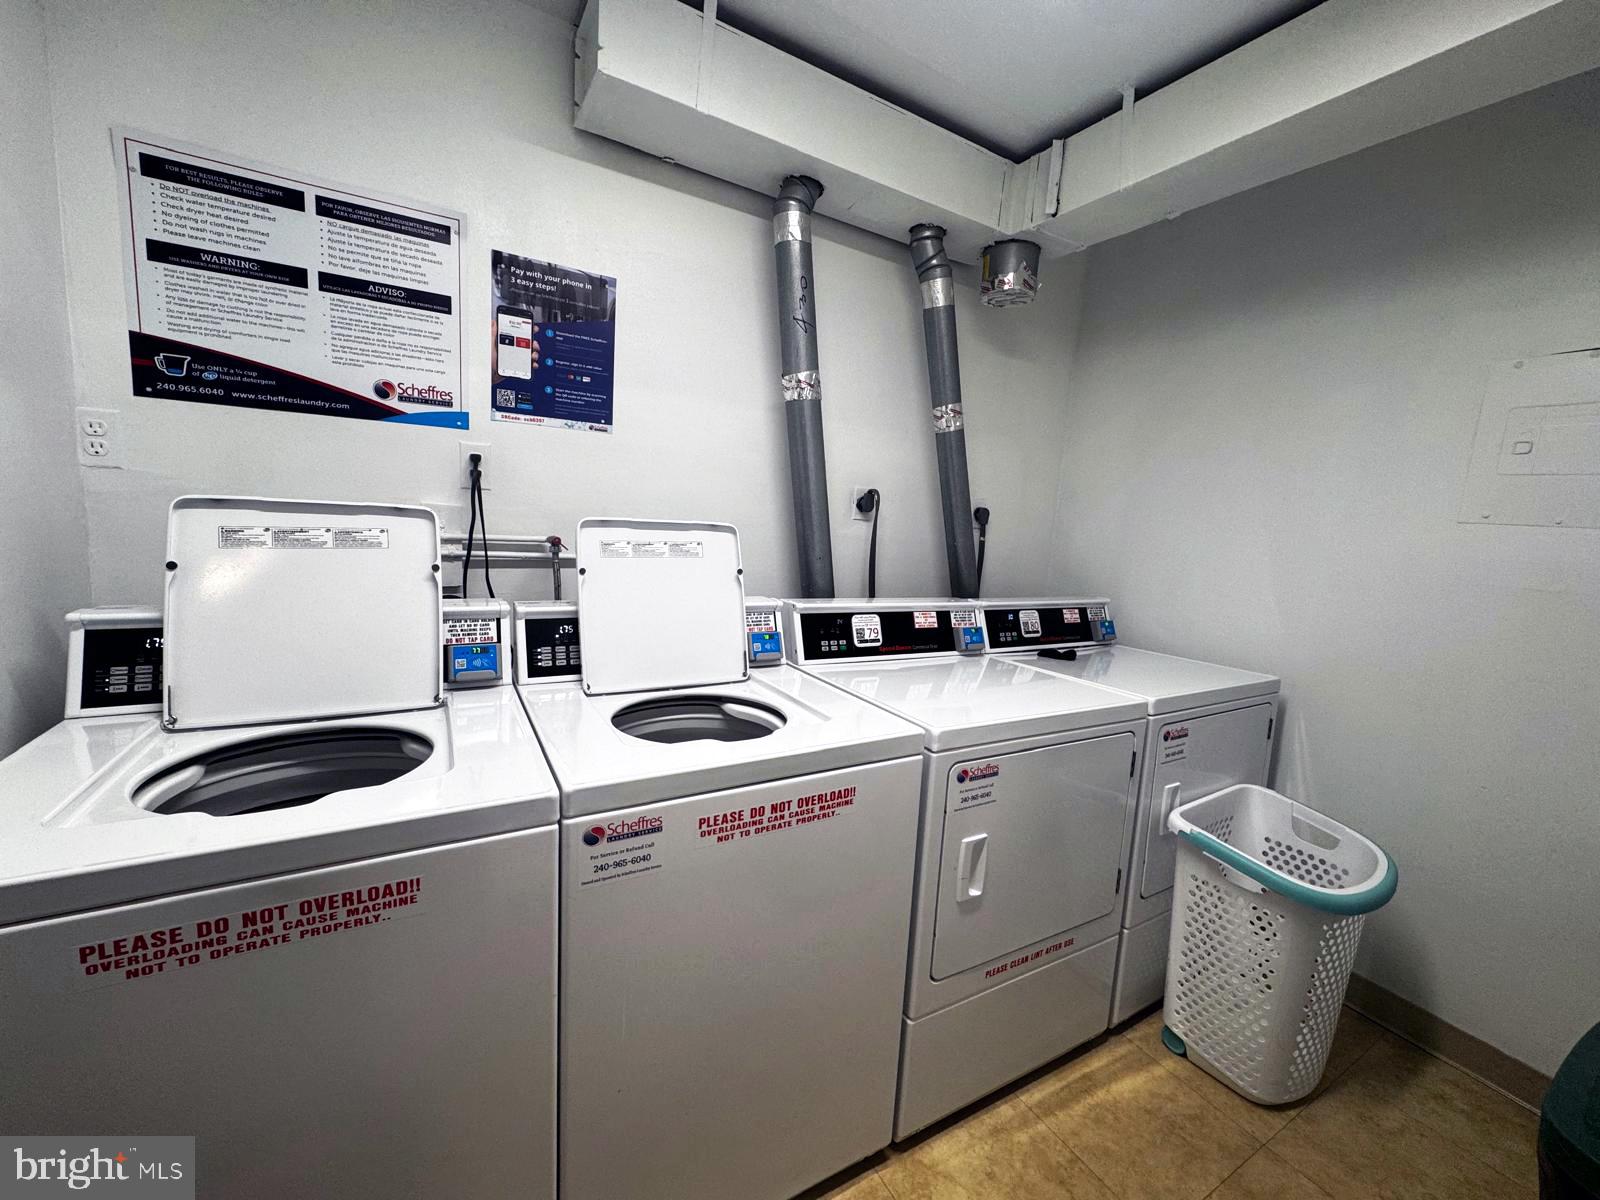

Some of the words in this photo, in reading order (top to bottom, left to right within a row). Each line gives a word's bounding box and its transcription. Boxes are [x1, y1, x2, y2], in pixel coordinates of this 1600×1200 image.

[160, 183, 170, 192] Do
[172, 185, 189, 196] NOT
[190, 191, 222, 202] overload
[224, 196, 236, 205] the
[160, 192, 184, 203] Check
[184, 199, 206, 208] water
[207, 201, 250, 217] temperature
[251, 210, 277, 222] desired
[160, 201, 184, 212] Check
[186, 206, 206, 216] dryer
[206, 210, 222, 220] heat
[223, 213, 249, 225] desired
[162, 210, 173, 219] No
[174, 212, 199, 225] dyeing
[200, 218, 208, 226] of
[209, 220, 236, 231] clothes
[236, 226, 270, 238] permitted
[162, 219, 174, 227] Do
[188, 225, 208, 234] wash
[209, 229, 225, 238] rugs
[226, 231, 234, 239] in
[234, 234, 266, 245] machines
[162, 228, 186, 238] Please
[187, 232, 207, 242] leave
[208, 237, 242, 248] machines
[242, 243, 261, 252] clean
[200, 252, 260, 270] WARNING:
[511, 266, 524, 276] Pay
[526, 270, 542, 279] with
[544, 274, 560, 283] your
[562, 279, 584, 288] phone
[586, 282, 592, 290] in
[517, 278, 534, 288] easy
[536, 282, 557, 292] steps!
[368, 284, 406, 298] ADVISO:
[206, 365, 228, 373] ONLY
[156, 382, 224, 396] 240.965.6040
[232, 390, 350, 409] www.scheffreslaundry.com
[398, 382, 453, 400] Scheffres
[866, 628, 879, 638] 79
[1030, 621, 1040, 630] 80
[970, 764, 999, 777] Scheffres
[699, 812, 744, 830] PLEASE
[750, 806, 766, 817] DO
[770, 800, 792, 814] NOT
[798, 786, 856, 810] OVERLOAD!!
[700, 819, 764, 838] OVERLOADING
[768, 812, 785, 824] CAN
[789, 807, 816, 819] CAUSE
[820, 798, 854, 814] MACHINE
[608, 816, 662, 836] Scheffres
[716, 833, 736, 844] NOT
[739, 830, 751, 838] TO
[754, 820, 792, 835] OPERATE
[594, 854, 652, 873] 240-965-6040
[600, 850, 618, 858] Service
[79, 926, 182, 964] PLEASE
[197, 916, 229, 939] DO
[242, 904, 288, 927] NOT
[300, 877, 421, 917] OVERLOAD!!
[85, 935, 227, 976] OVERLOADING
[237, 923, 274, 942] CAN
[283, 912, 338, 931] CAUSE
[346, 894, 418, 918] MACHINE
[126, 961, 166, 980] NOT
[178, 954, 200, 968] TO
[210, 932, 292, 960] OPERATE
[985, 964, 1008, 979] PLEASE
[1010, 956, 1028, 968] CLEAN
[1030, 949, 1044, 960] LINT
[1045, 942, 1062, 954] AFTER
[1064, 938, 1074, 948] USE
